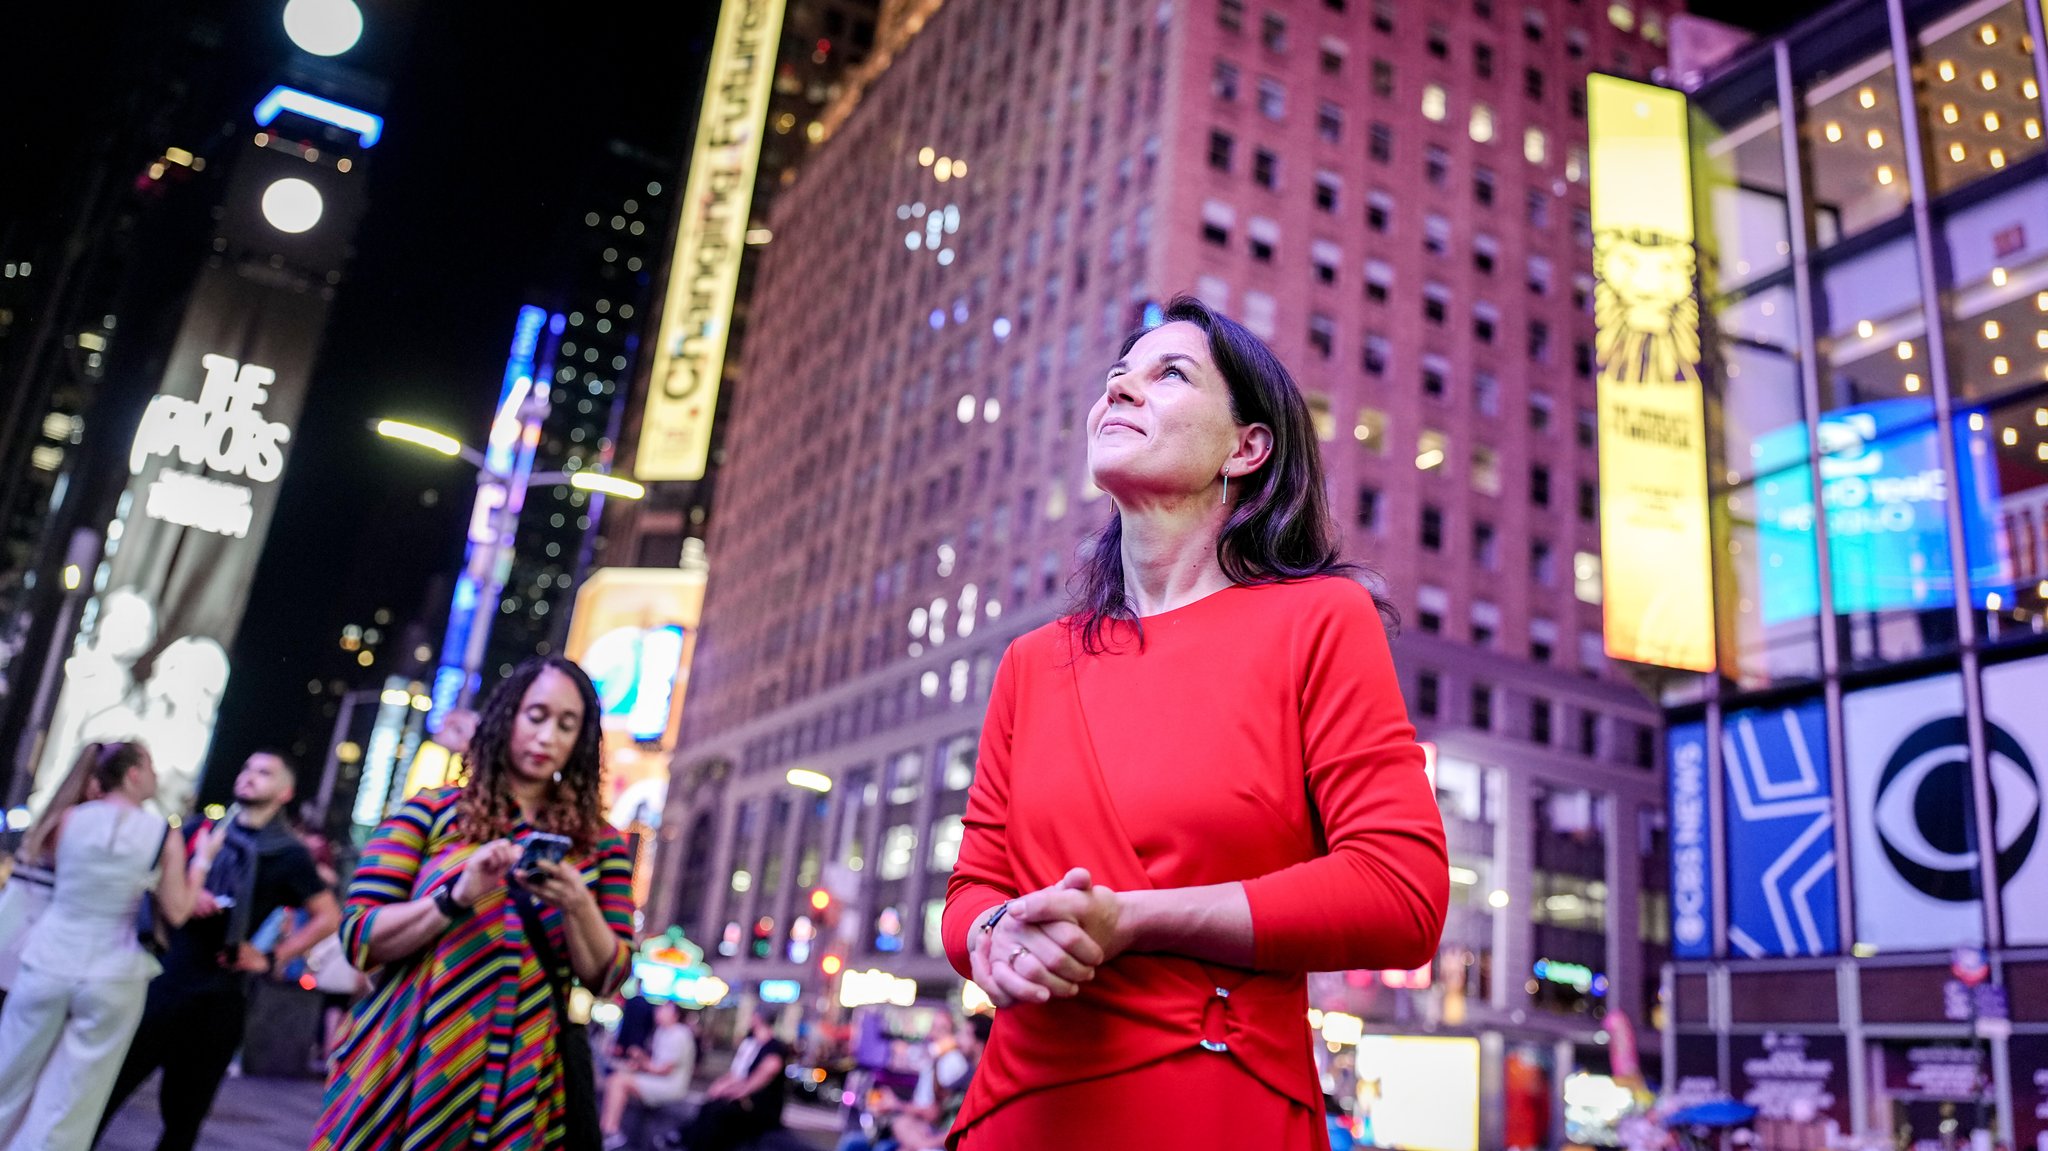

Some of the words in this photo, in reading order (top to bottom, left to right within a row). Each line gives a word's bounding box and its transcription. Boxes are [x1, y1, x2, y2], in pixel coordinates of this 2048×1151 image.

[664, 168, 742, 400] Changing
[202, 353, 276, 420] THE
[1673, 741, 1704, 845] NEWS
[1674, 846, 1704, 917] CBS
